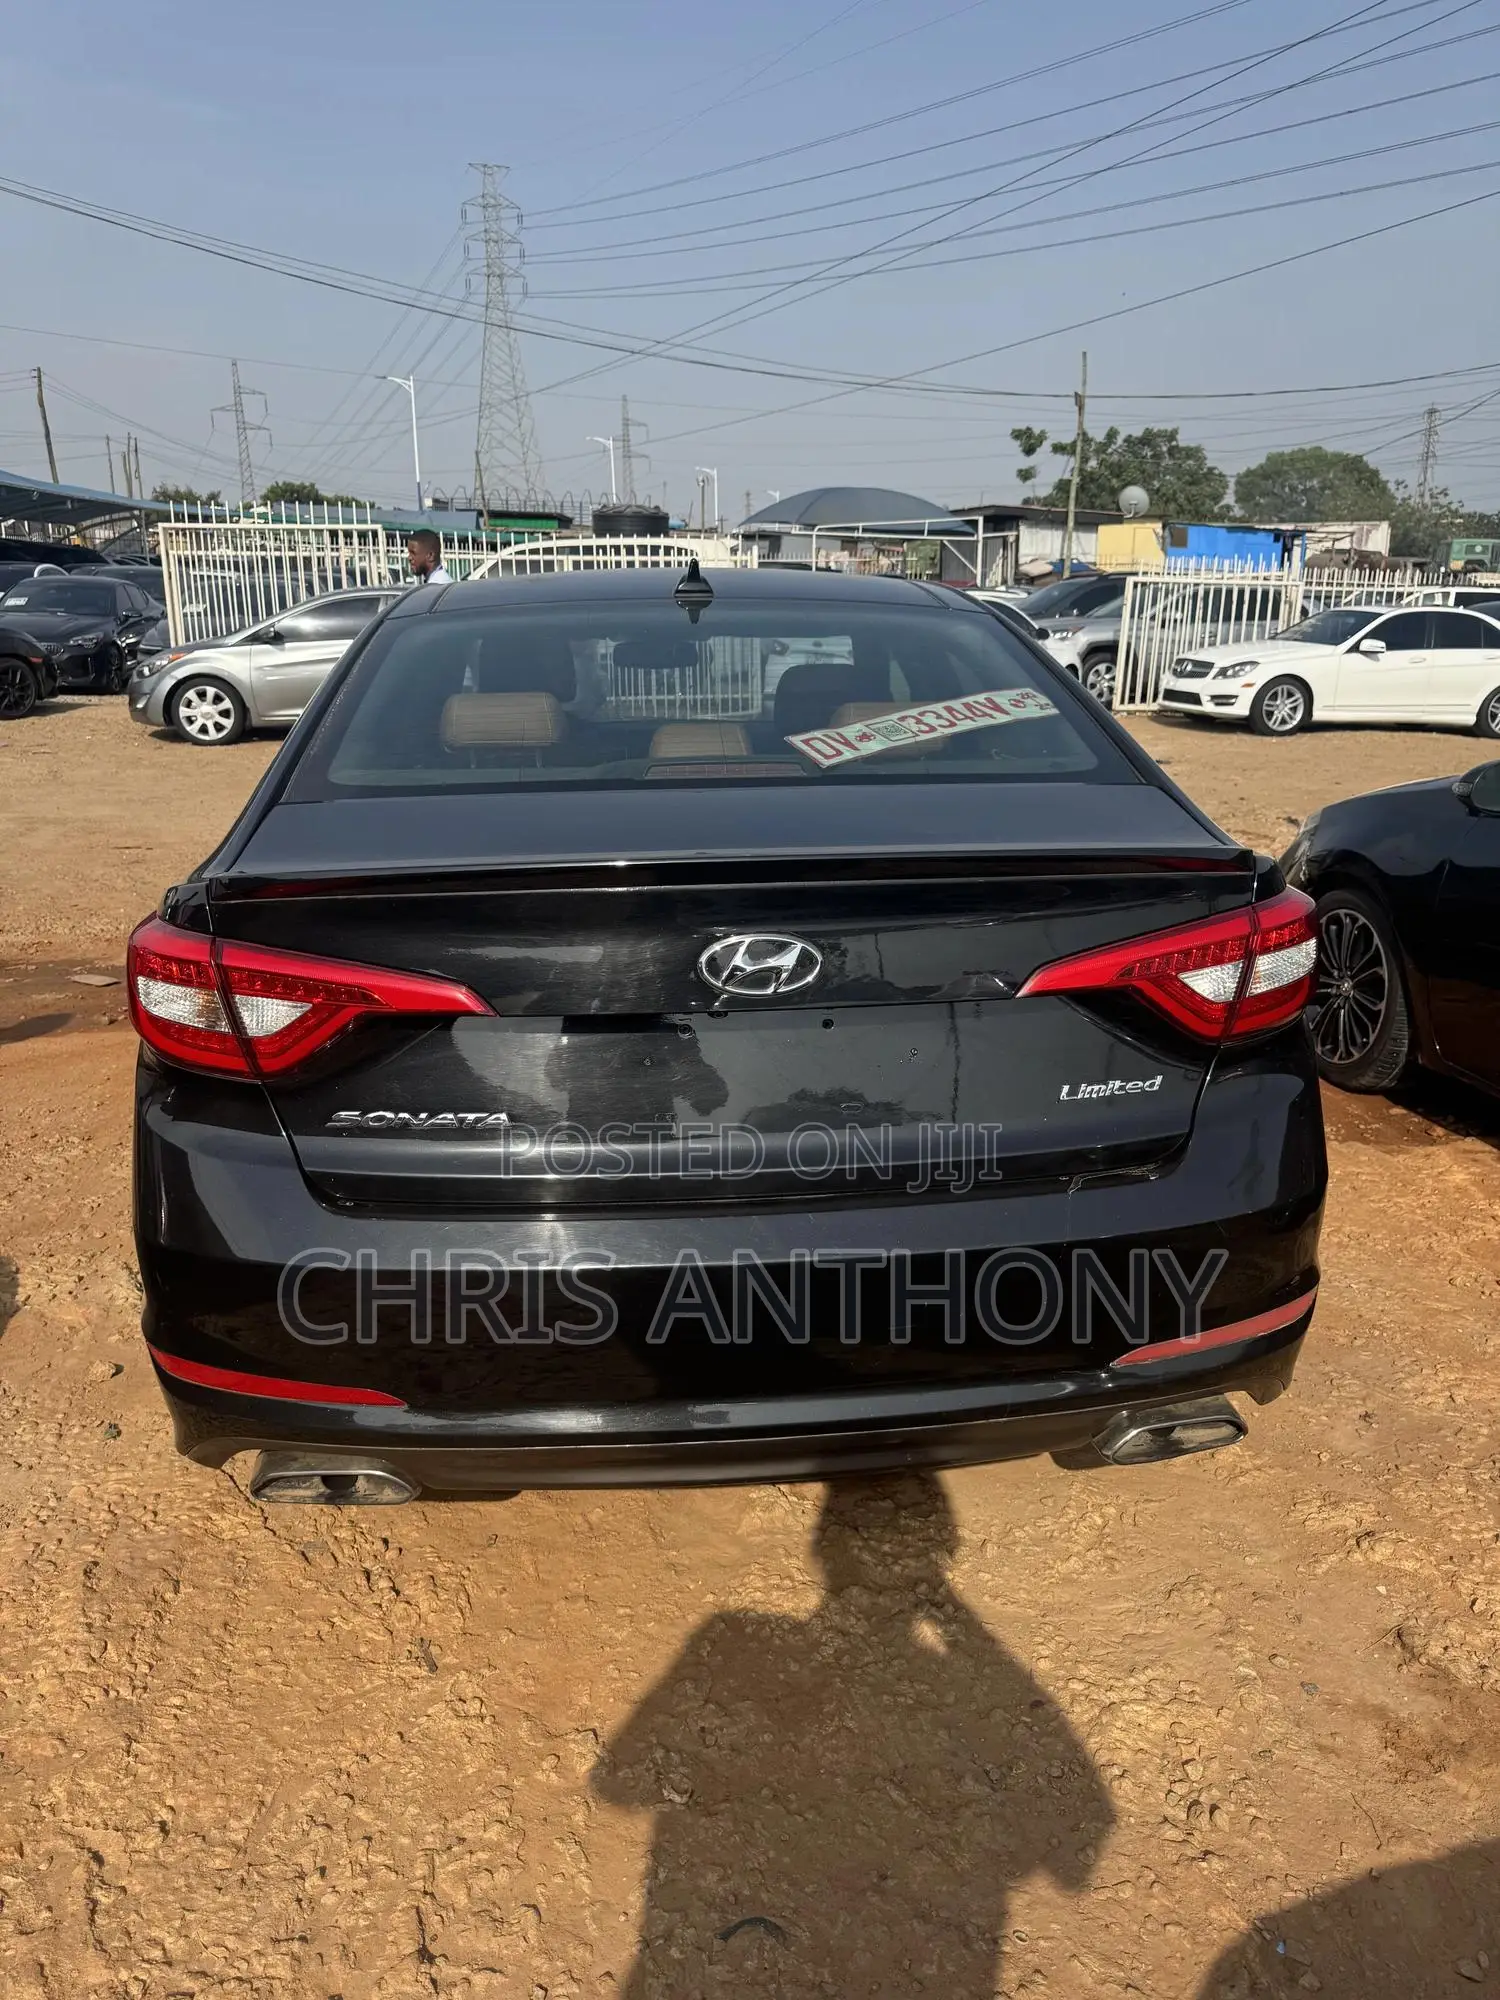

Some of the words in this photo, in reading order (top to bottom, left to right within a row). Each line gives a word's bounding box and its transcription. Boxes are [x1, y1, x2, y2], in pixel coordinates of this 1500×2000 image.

[801, 731, 860, 760] DV
[1059, 1075, 1163, 1101] Limited
[326, 1111, 513, 1129] SONATA
